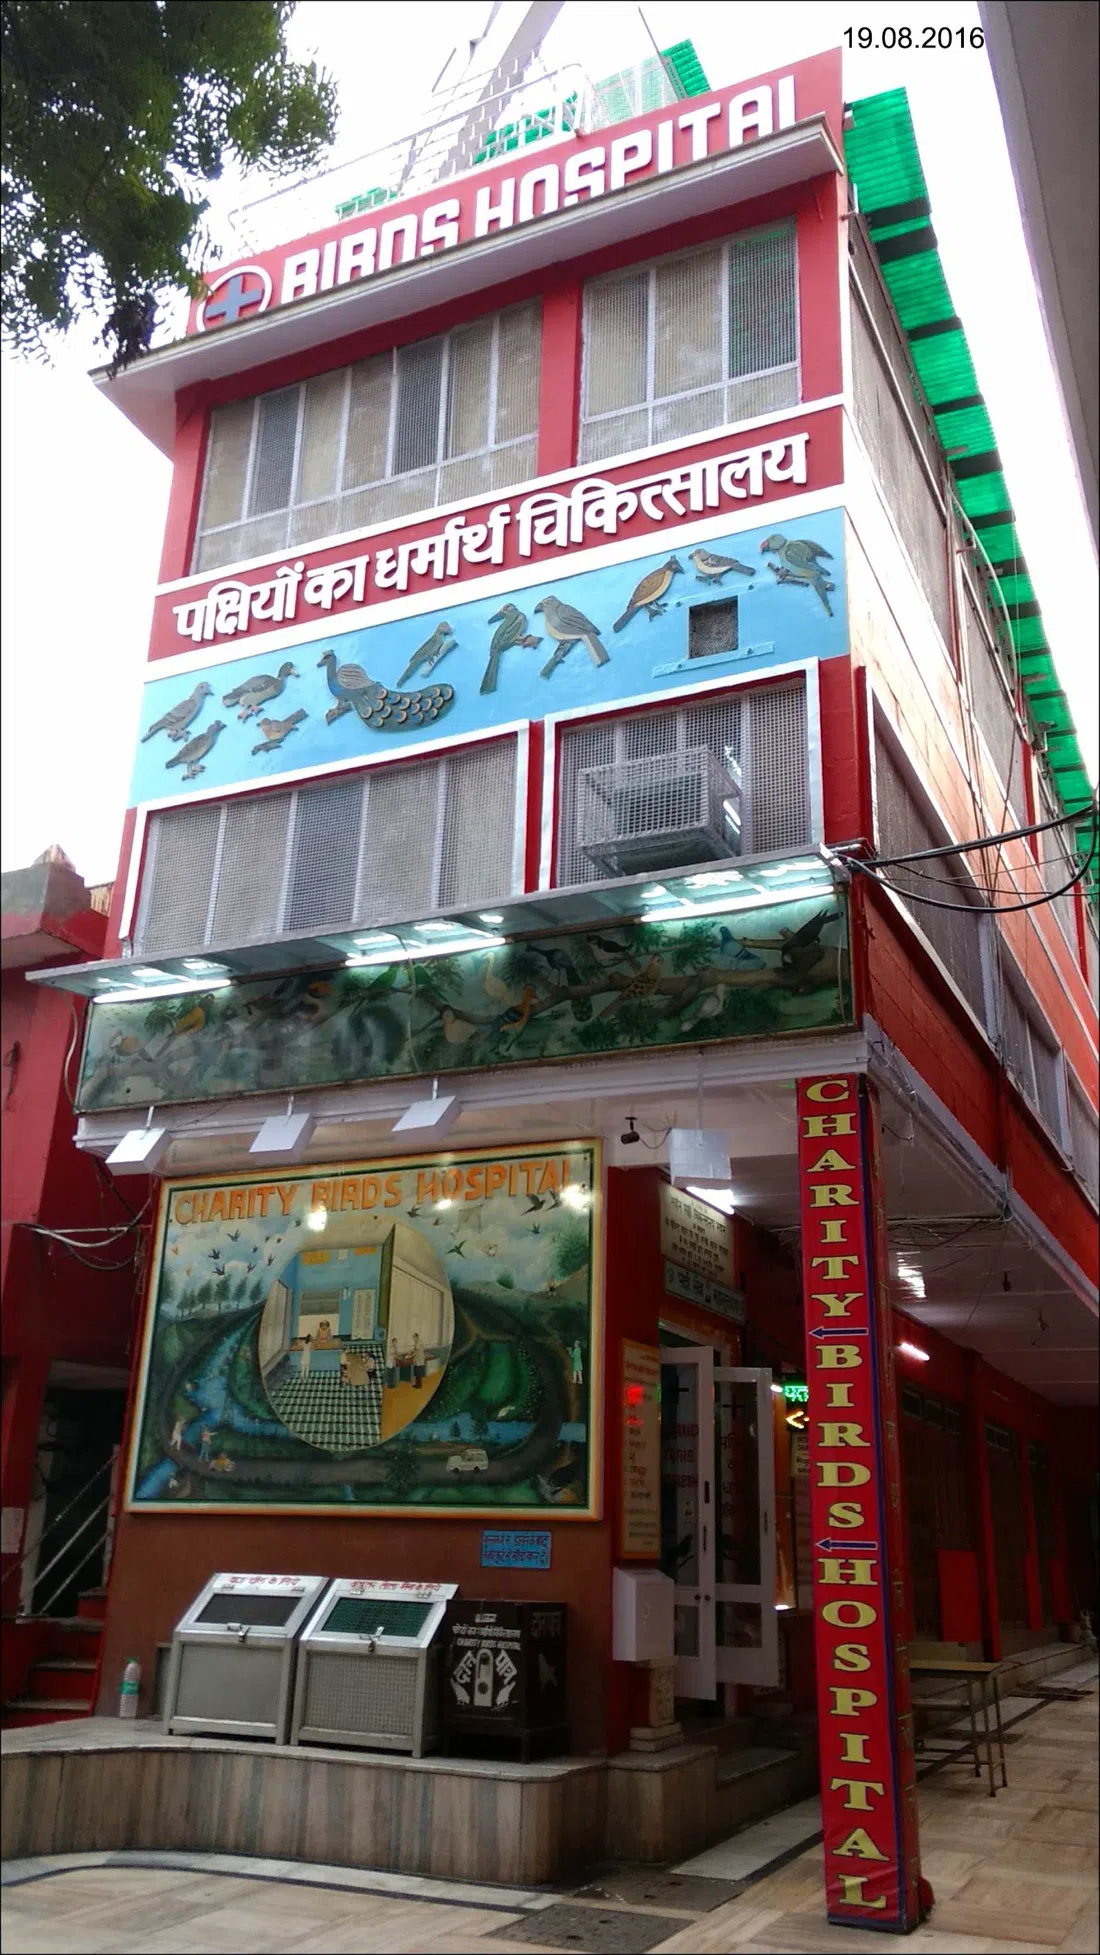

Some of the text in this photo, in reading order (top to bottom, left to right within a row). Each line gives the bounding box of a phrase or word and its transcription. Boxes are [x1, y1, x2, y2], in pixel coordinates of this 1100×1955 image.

[173, 431, 811, 643] पक्षियों का धर्मार्थ चिकित्सालय
[174, 1184, 298, 1226] CHARITY
[311, 1172, 403, 1214] BIRDS
[803, 1078, 890, 1910] CHARITY BIRDS HOSPITAL
